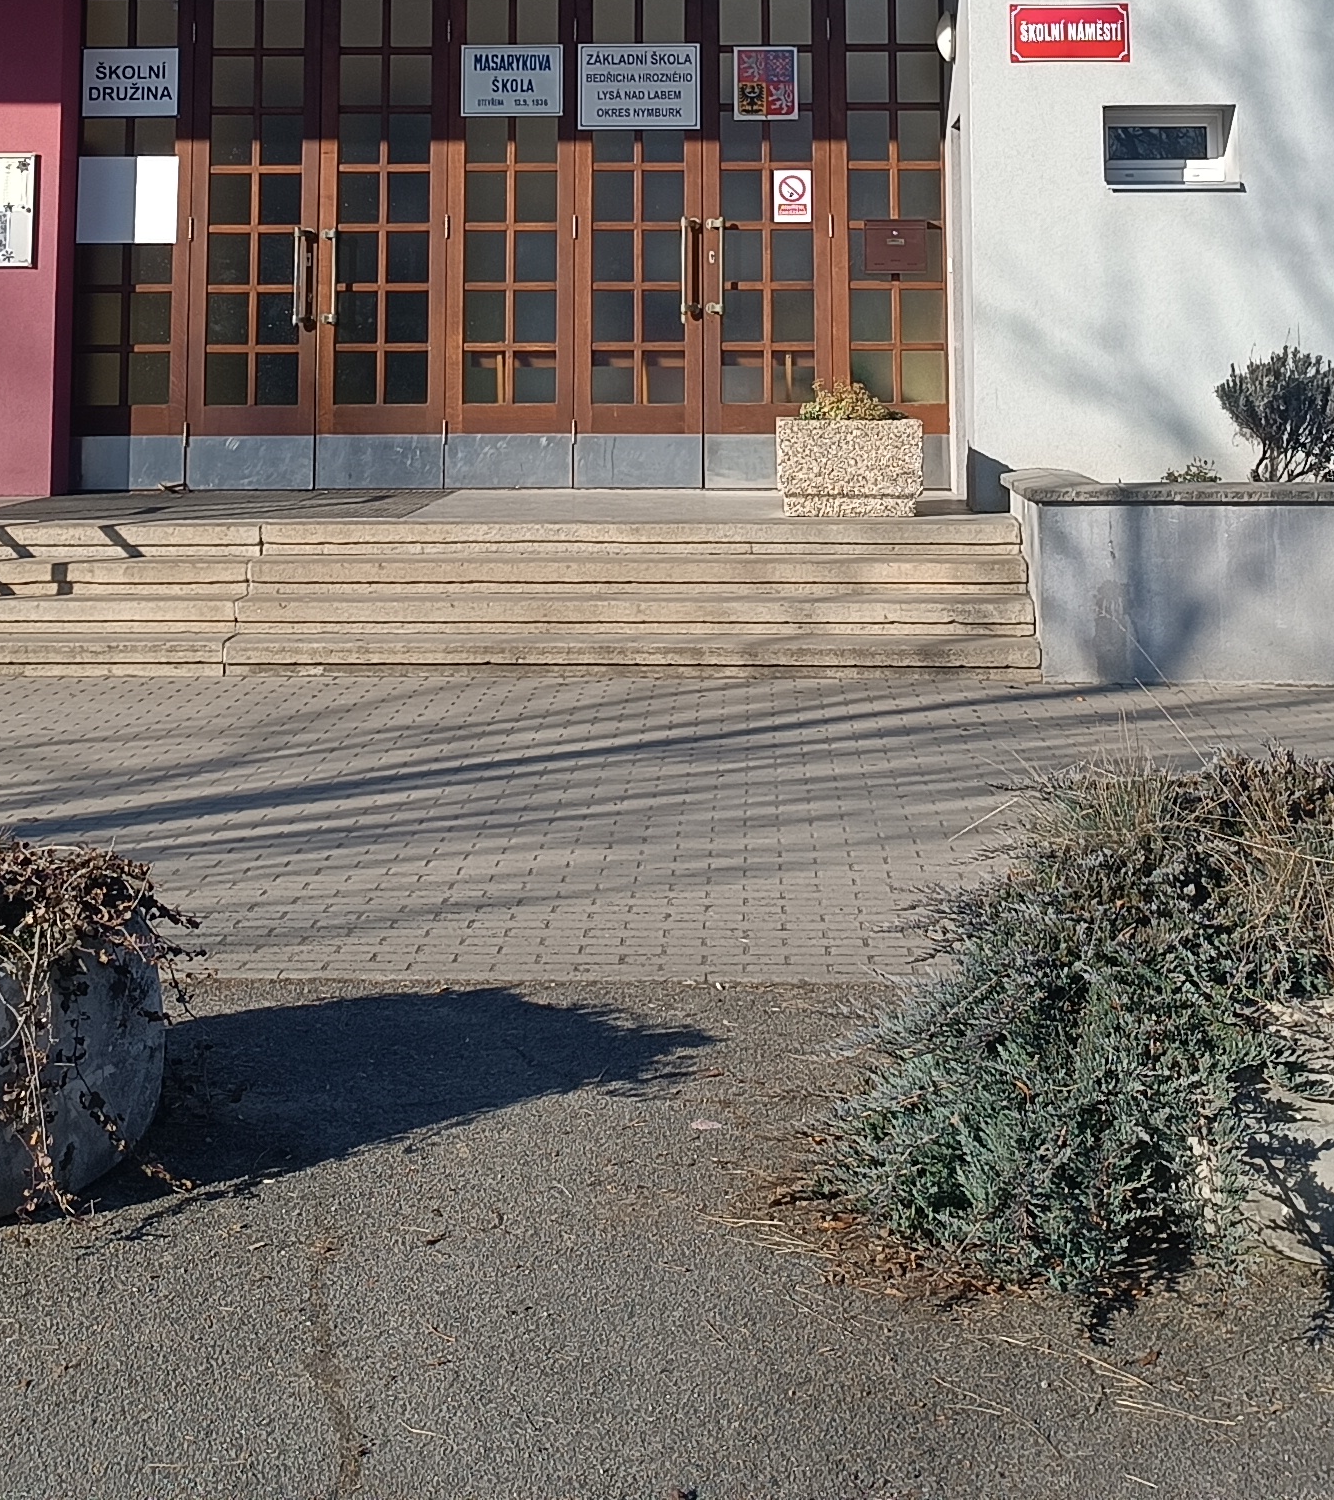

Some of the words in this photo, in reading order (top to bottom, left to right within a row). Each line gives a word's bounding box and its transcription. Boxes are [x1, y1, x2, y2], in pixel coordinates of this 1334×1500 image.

[1020, 19, 1065, 42] ŠKOLNÍ
[1068, 19, 1123, 41] NÁMĚSTÍ
[473, 53, 551, 71] MASARYKOVA
[586, 51, 648, 66] ZÁKLADNÍ
[650, 51, 693, 65] ŠKOLA
[95, 61, 166, 80] ŠKOLNÍ
[586, 71, 636, 83] BEDŘICHA
[638, 71, 693, 83] HROZNÉHO
[88, 82, 173, 101] DRUŽINA
[491, 76, 534, 93] ŠKOLA
[597, 88, 622, 100] LYSÁ
[624, 90, 645, 100] NAD
[647, 90, 681, 100] LABEM
[596, 107, 631, 118] OKRES
[633, 107, 682, 118] NYMBURK
